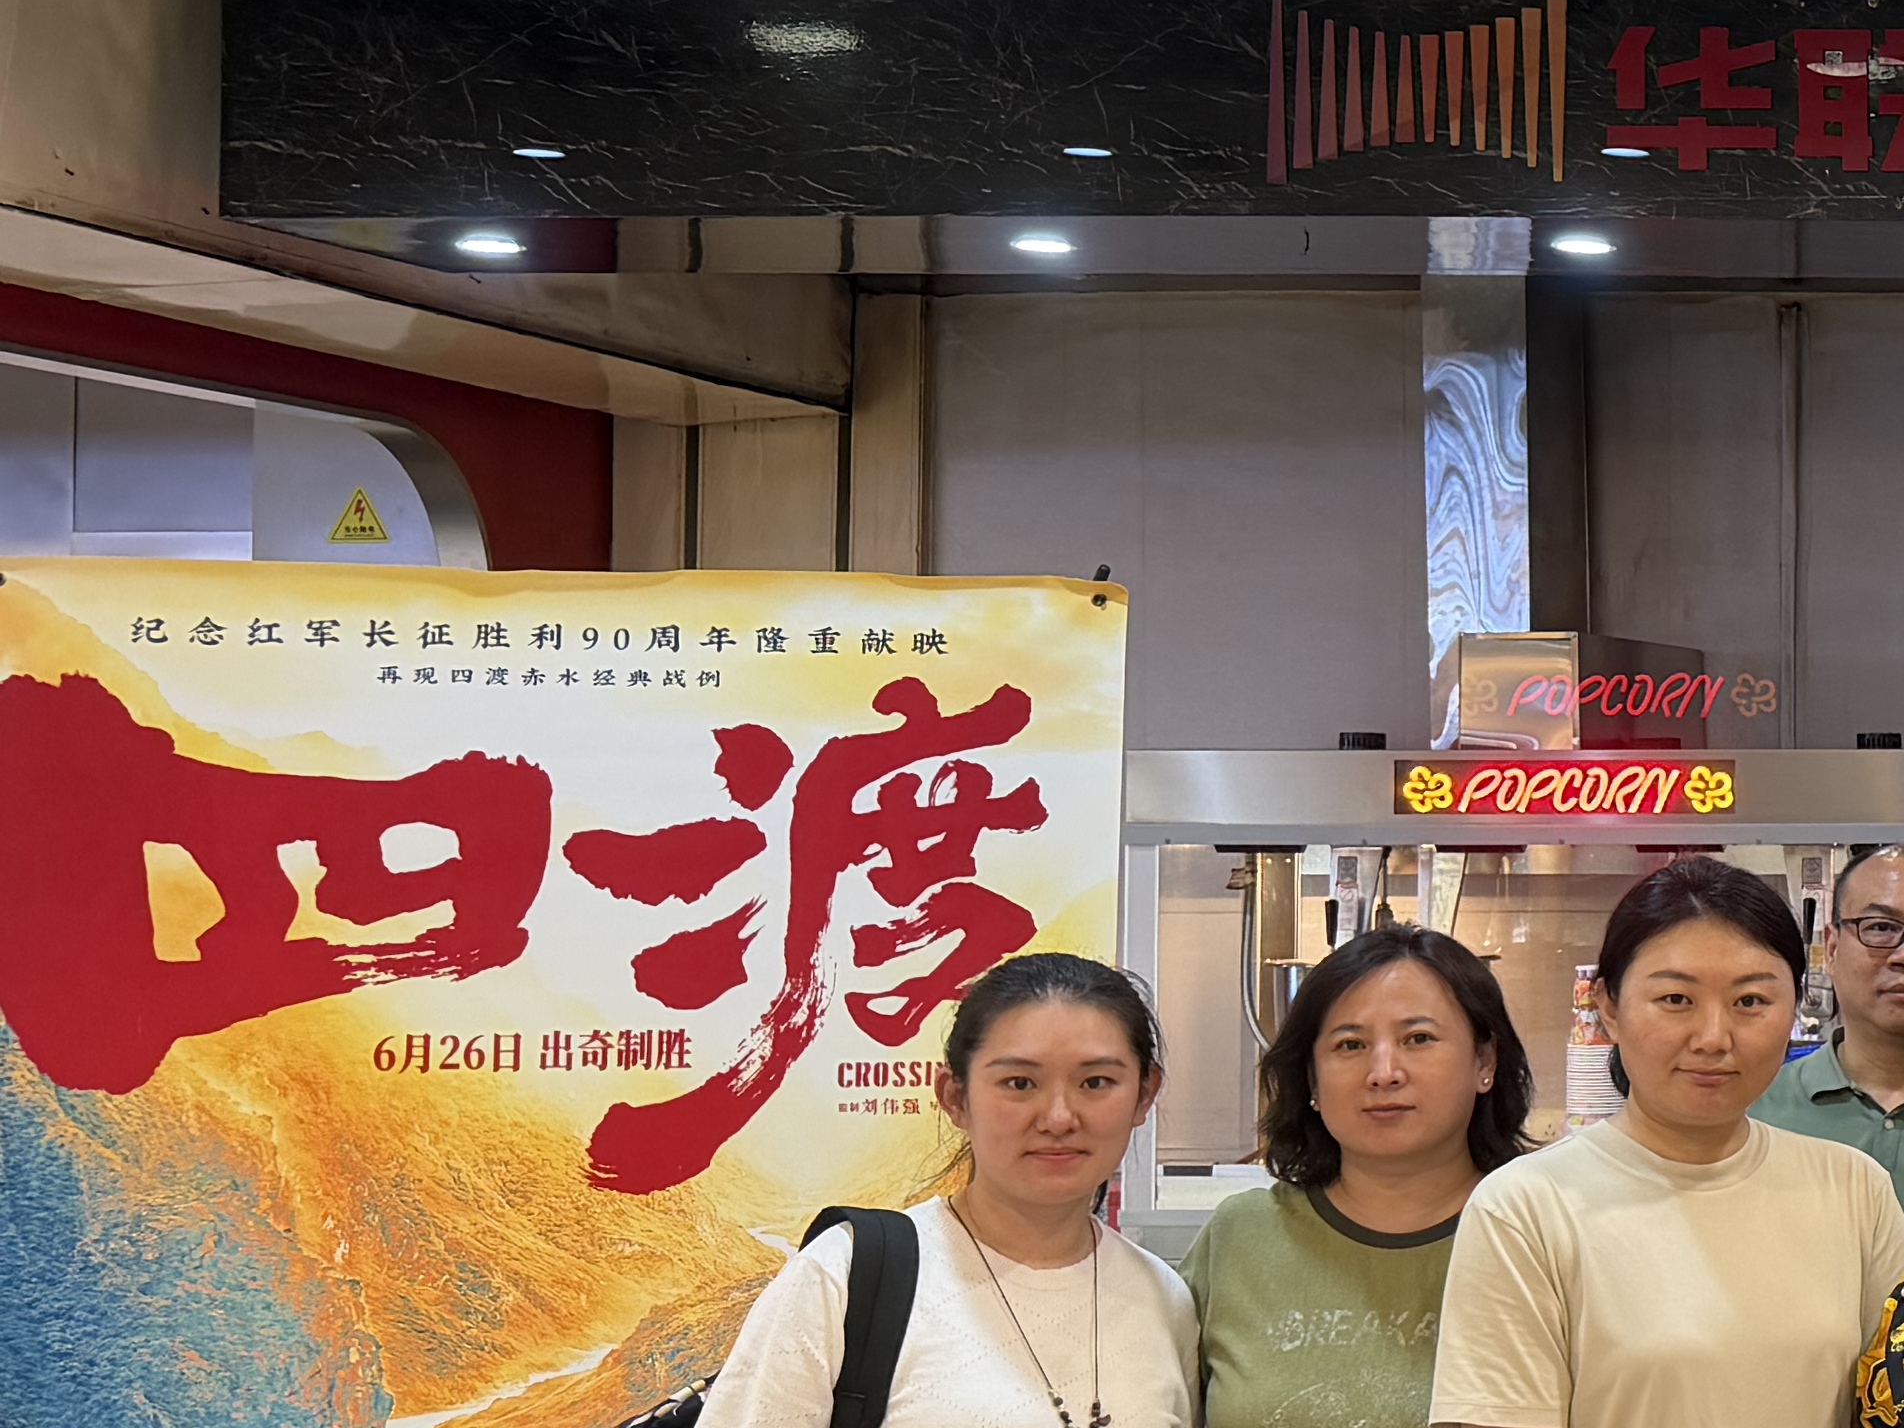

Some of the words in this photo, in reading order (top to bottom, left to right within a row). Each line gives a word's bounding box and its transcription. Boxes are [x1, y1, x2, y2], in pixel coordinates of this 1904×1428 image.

[131, 616, 950, 656] 纪念红军长征胜利90周年隆重献映
[376, 665, 722, 689] 再现四渡赤水经典战例
[1507, 673, 1724, 718] POPCORN
[1457, 766, 1682, 814] POPCORN
[0, 676, 1049, 1195] 四渡
[373, 1033, 523, 1074] 6月26日
[539, 1029, 693, 1072] 出奇制胜
[860, 1098, 920, 1115] 刘伟强
